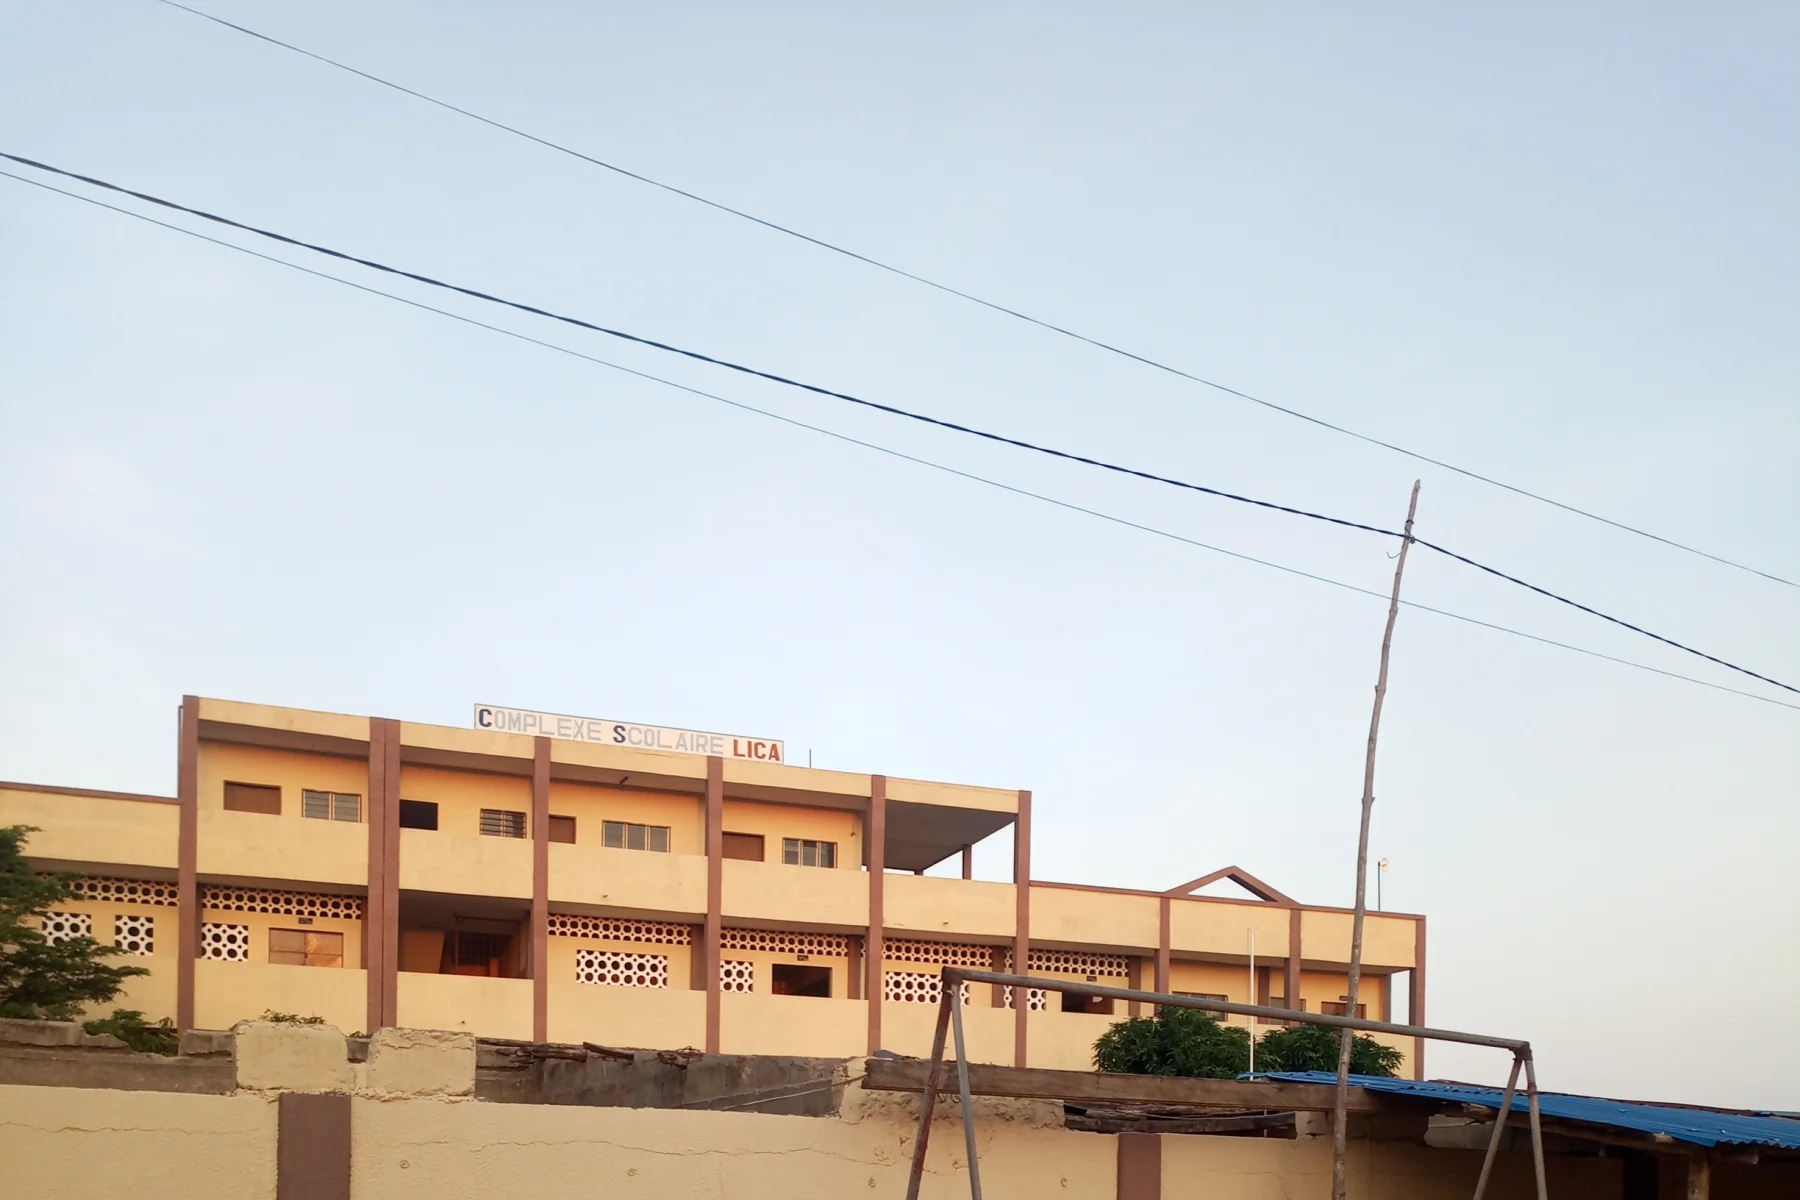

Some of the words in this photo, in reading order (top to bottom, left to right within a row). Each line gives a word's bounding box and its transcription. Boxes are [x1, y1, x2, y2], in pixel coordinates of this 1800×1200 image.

[478, 708, 602, 741] COMPLEXE
[612, 725, 724, 755] SCOLAIRE
[732, 739, 781, 761] LICA
